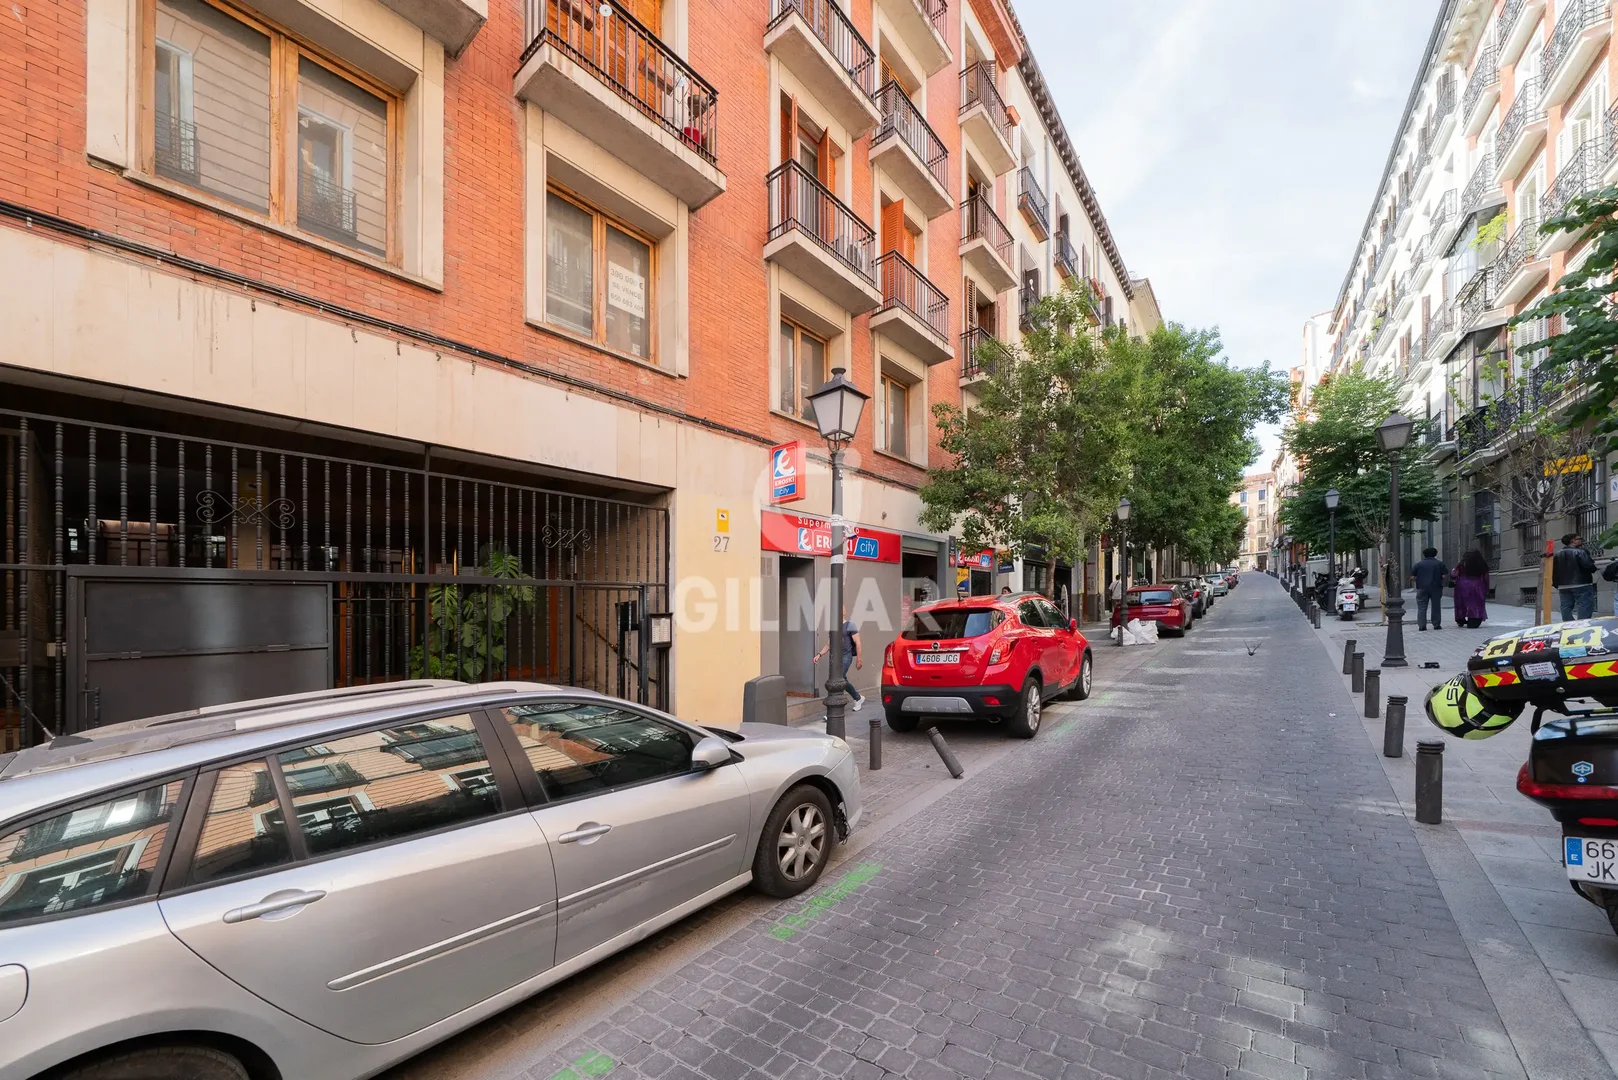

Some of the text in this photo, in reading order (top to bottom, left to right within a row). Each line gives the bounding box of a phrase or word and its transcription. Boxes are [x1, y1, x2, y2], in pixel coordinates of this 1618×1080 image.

[774, 476, 795, 487] EROSKI
[713, 535, 730, 553] 27
[860, 541, 876, 556] city
[921, 654, 958, 663] 4606 JCG
[1586, 841, 1618, 860] 66
